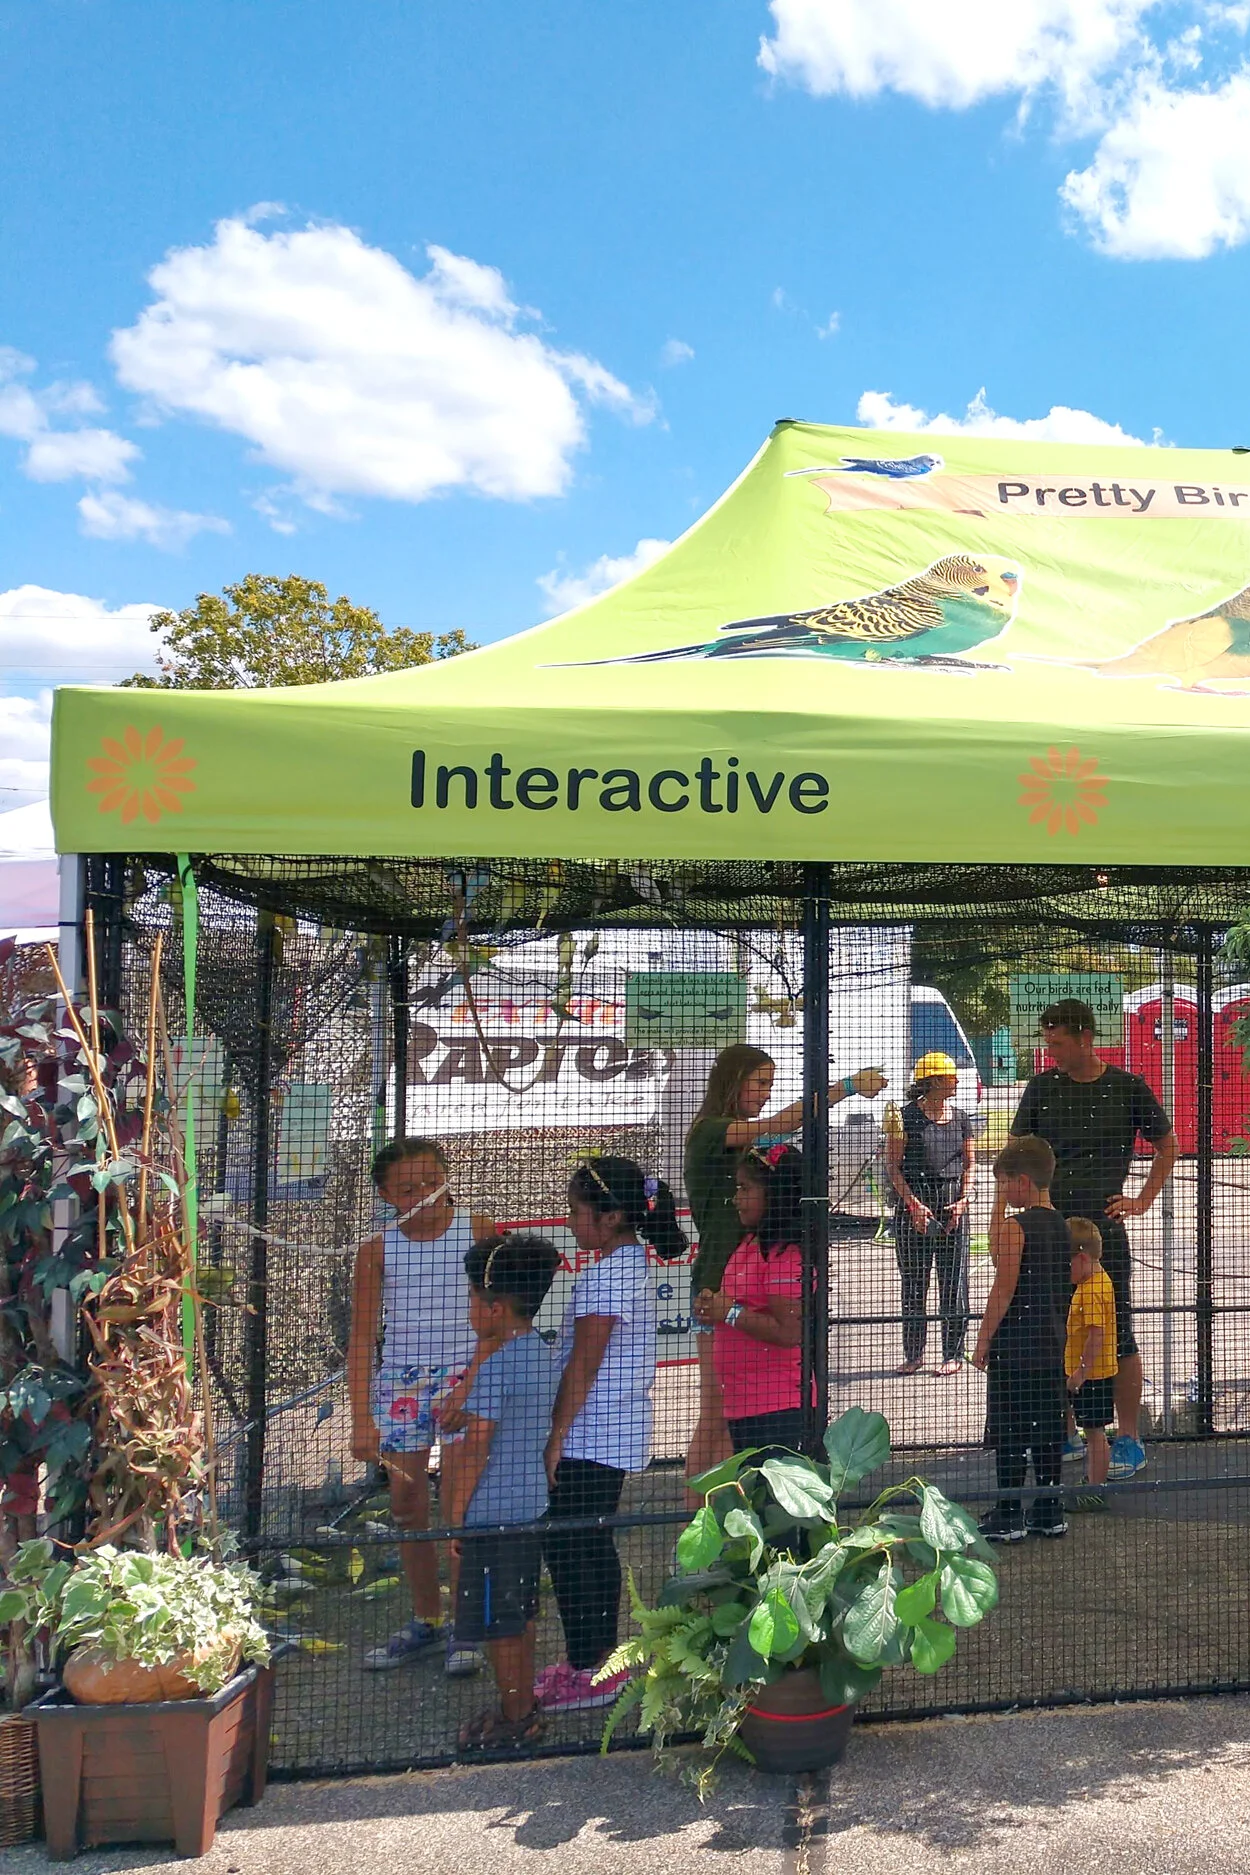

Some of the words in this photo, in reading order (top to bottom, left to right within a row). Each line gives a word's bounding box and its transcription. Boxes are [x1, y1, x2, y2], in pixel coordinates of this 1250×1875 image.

[997, 481, 1156, 512] Pretty
[410, 750, 830, 814] Interactive
[1016, 1000, 1050, 1012] nutriti
